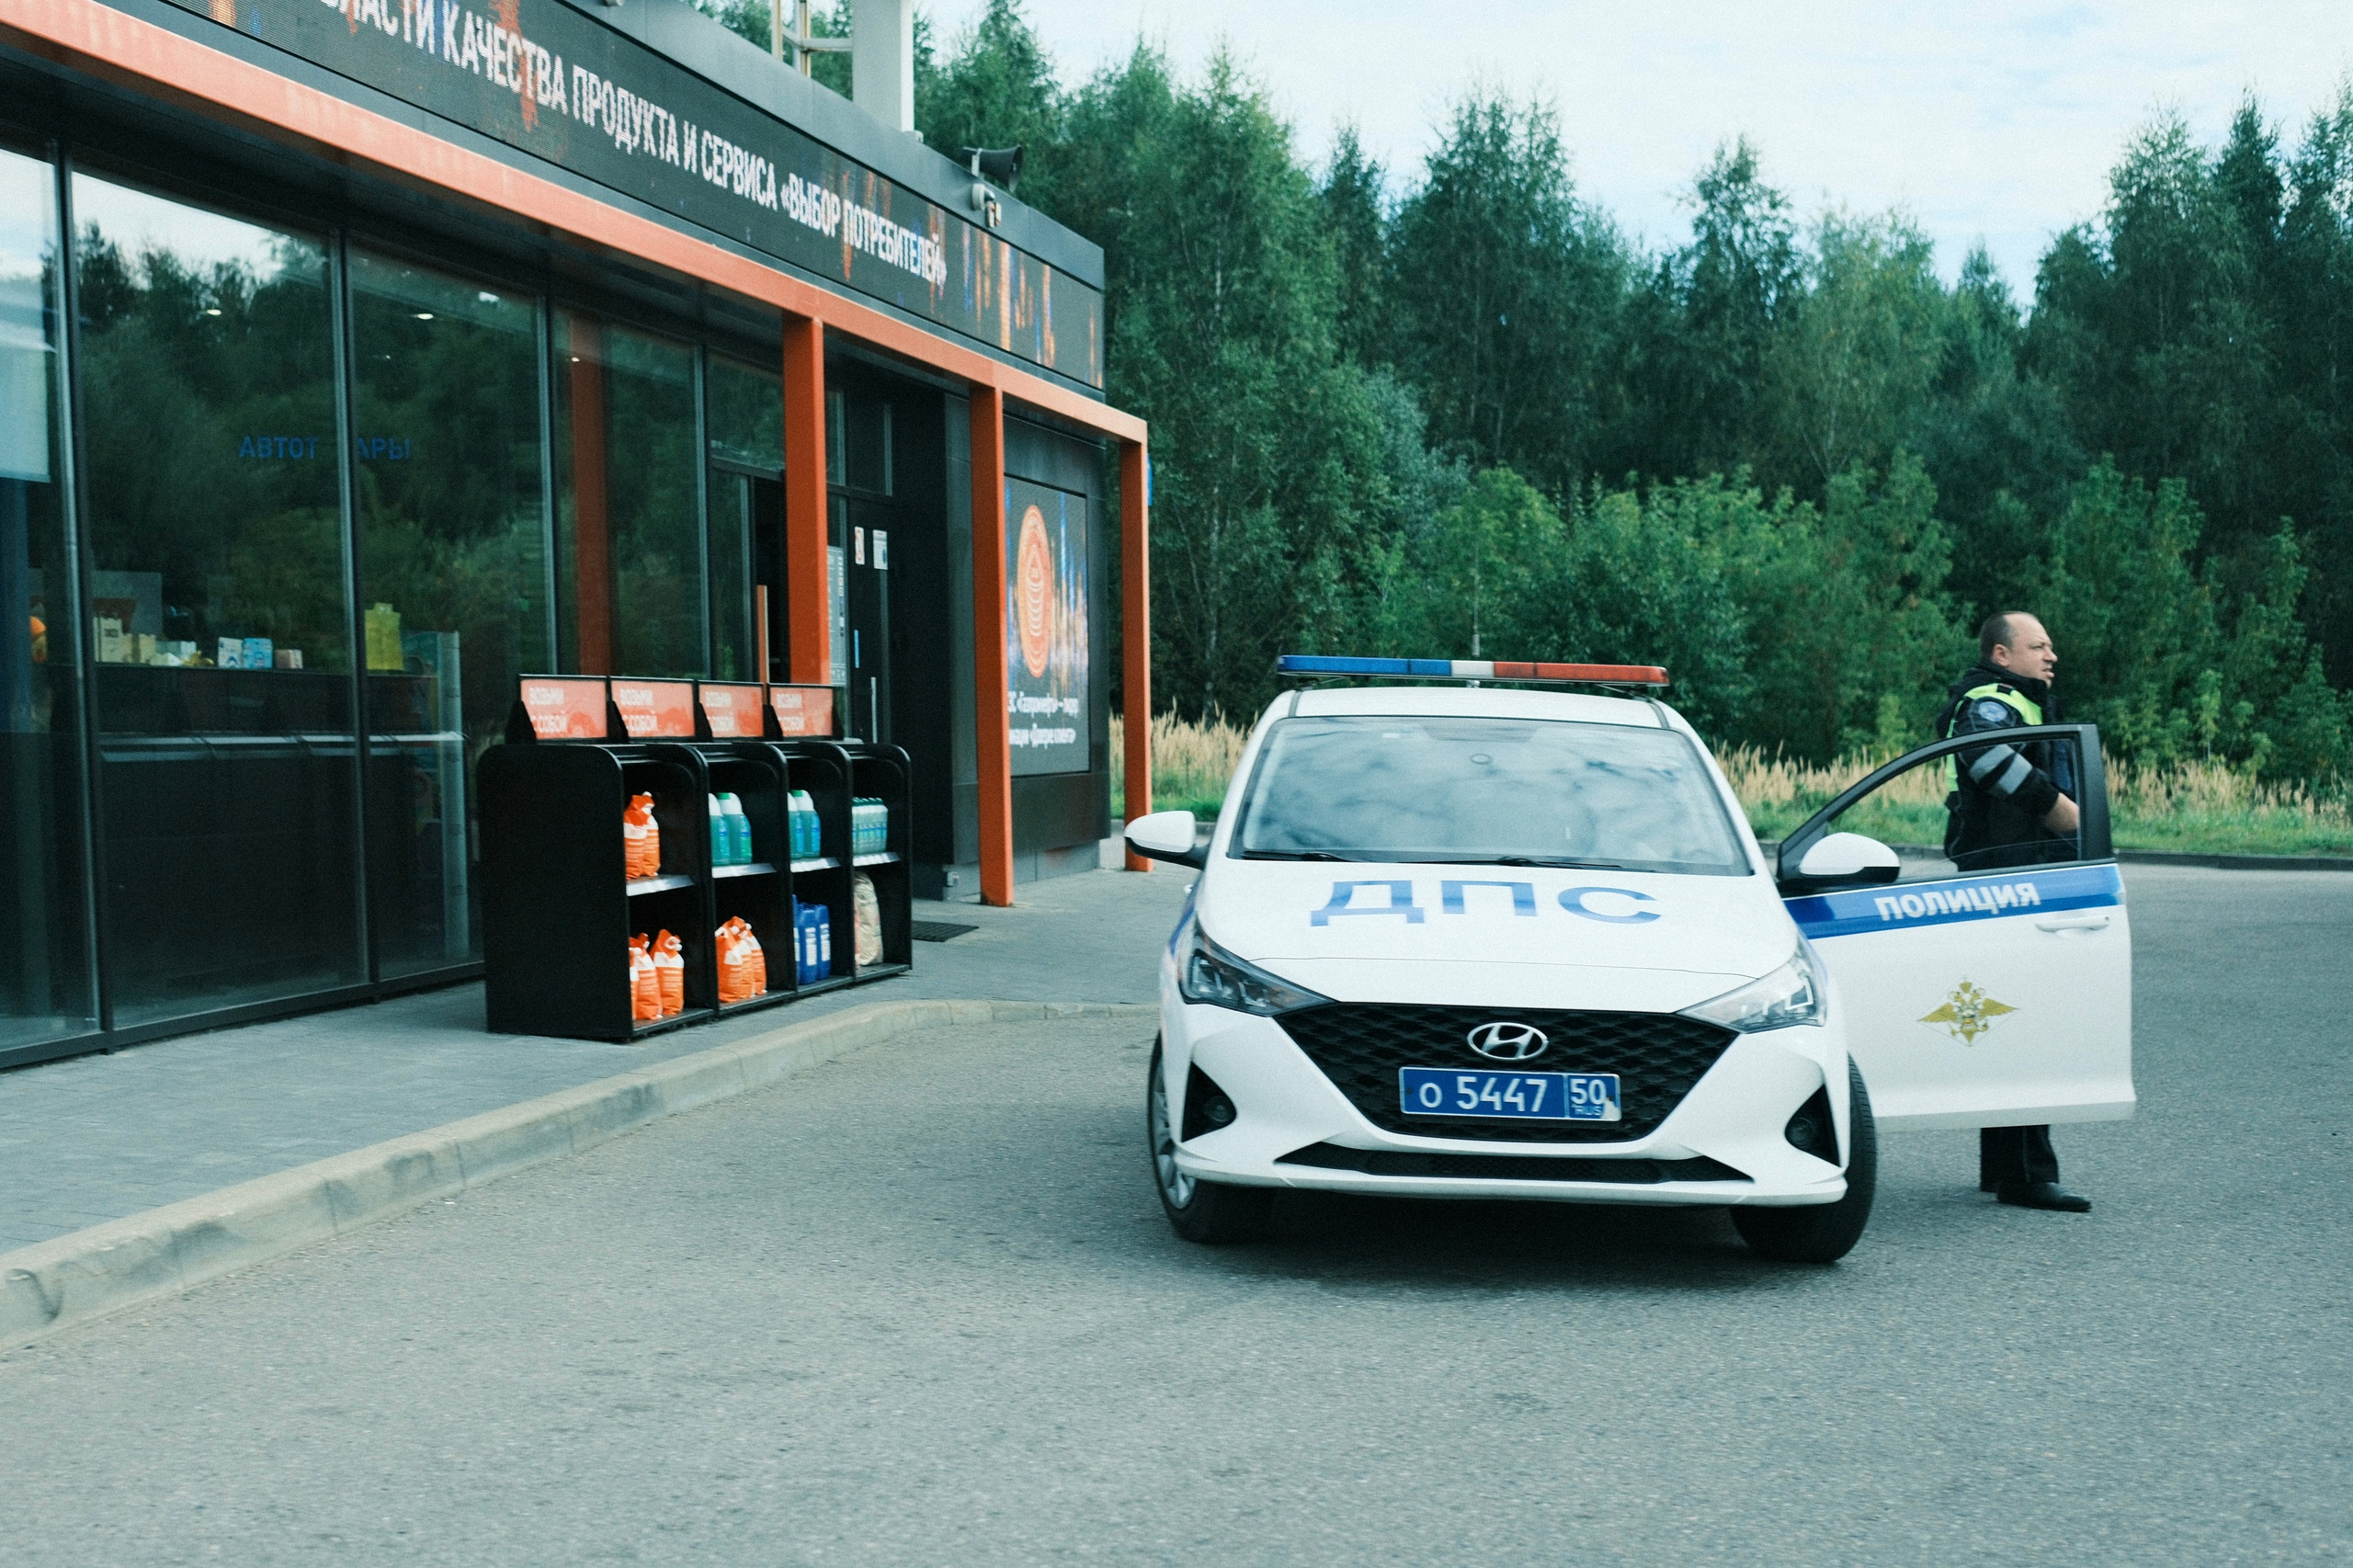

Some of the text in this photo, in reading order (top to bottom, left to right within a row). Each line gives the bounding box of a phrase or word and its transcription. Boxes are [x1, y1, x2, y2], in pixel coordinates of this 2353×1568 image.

[443, 0, 568, 115] КАЧЕСТВА
[573, 64, 680, 166] ПРОДУКТА
[683, 119, 697, 174] И
[701, 130, 778, 211] СЕРВИСА
[780, 172, 841, 237] «ВЫБОР
[843, 199, 948, 287] ПОТРЕБИТЕЛЕЙ»
[239, 436, 411, 460] АВТОТАРЫ
[1310, 880, 1662, 927] ДПС
[1873, 882, 2041, 921] ПОЛИЦИЯ
[1456, 1075, 1548, 1112] 5447
[1570, 1078, 1607, 1105] 50
